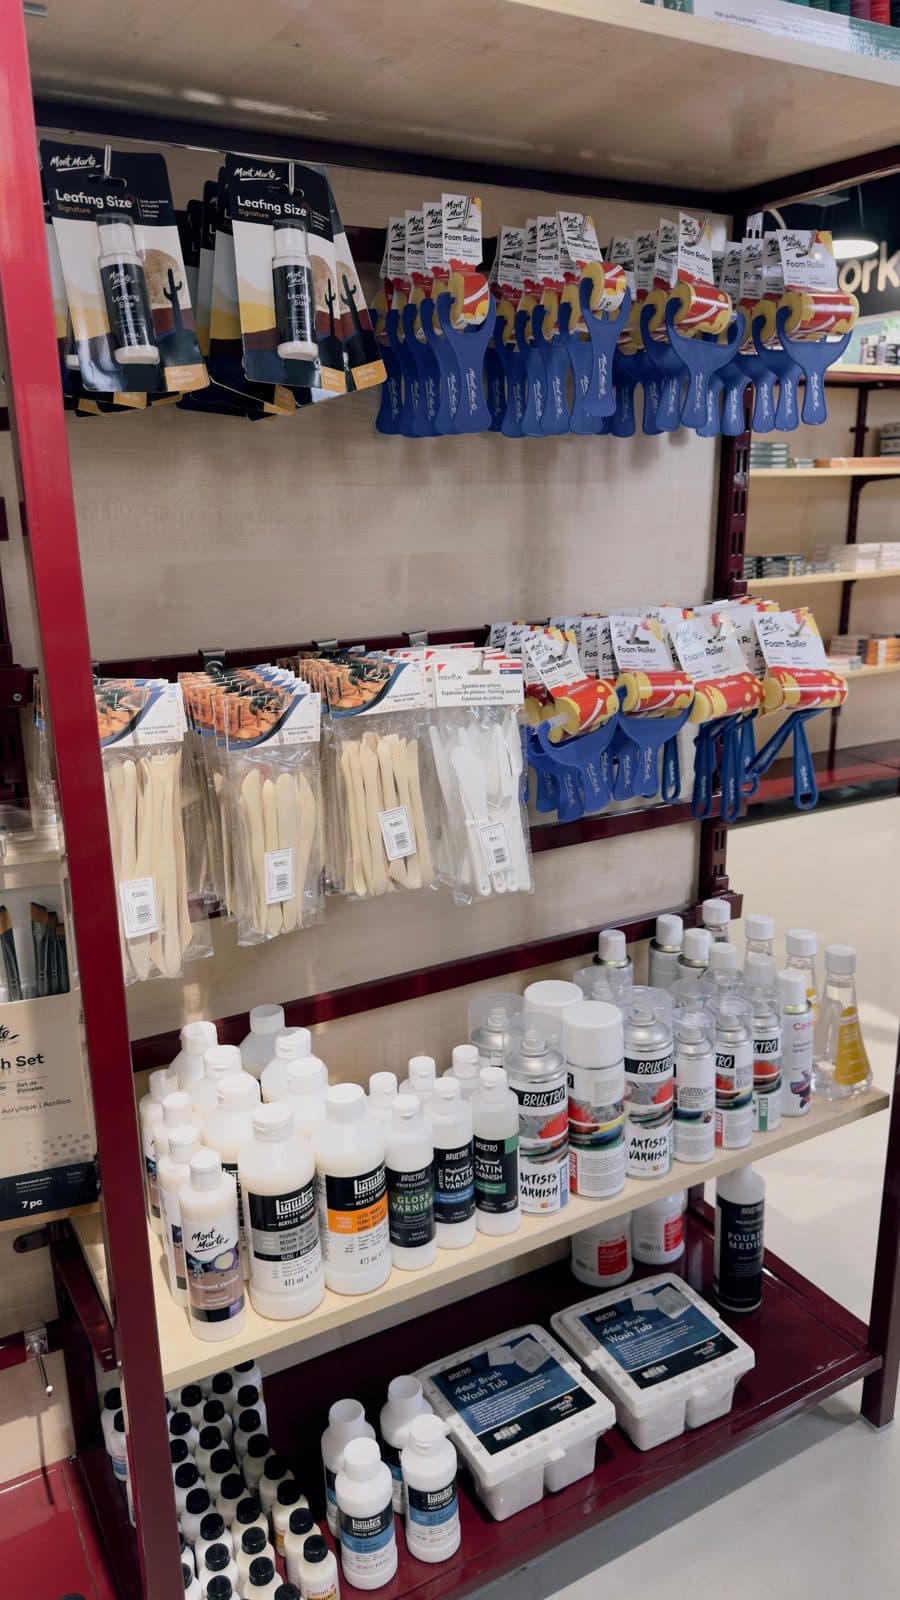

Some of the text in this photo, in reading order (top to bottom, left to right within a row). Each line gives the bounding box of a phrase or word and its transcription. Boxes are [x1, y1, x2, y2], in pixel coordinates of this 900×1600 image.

[50, 154, 71, 167] Mont
[234, 167, 254, 178] Mont
[55, 188, 133, 209] Leafing Size
[445, 200, 464, 209] Mont
[58, 203, 91, 214] Signature
[237, 194, 308, 217] Leafing Size
[238, 208, 269, 219] Signature
[449, 208, 466, 217] Mart
[563, 215, 578, 223] Mont
[540, 222, 556, 231] Mont
[444, 233, 481, 243] Foam Roller
[567, 240, 583, 248] Foam
[782, 234, 796, 242] Mont
[538, 253, 553, 261] Foam
[680, 245, 711, 262] Foam Roller
[786, 260, 826, 269] Foam Roller
[838, 240, 900, 293] ork
[743, 272, 762, 281] Foam
[759, 617, 773, 625] Mont
[763, 640, 808, 648] Foam Roller
[683, 645, 724, 662] Foam Roller
[540, 659, 573, 676] Foam Roller
[16, 1053, 45, 1068] Set
[522, 1084, 566, 1107] BRUSTRO
[1, 1103, 38, 1115] Acrylique
[628, 1147, 668, 1163] VARNISH
[475, 1161, 503, 1174] SATIN
[445, 1166, 474, 1183] MATTE
[475, 1169, 503, 1181] VARNISH
[397, 1191, 430, 1204] GLOSS
[520, 1184, 558, 1199] ARNISH
[21, 1198, 43, 1210] 7 pc
[278, 1217, 299, 1227] ACRYLIC
[192, 1226, 216, 1241] Mont
[728, 1230, 764, 1242] POURI
[624, 1314, 647, 1328] Brush
[606, 1322, 653, 1344] Wash Tub
[478, 1370, 502, 1385] Brush
[458, 1379, 508, 1403] Wash Tub
